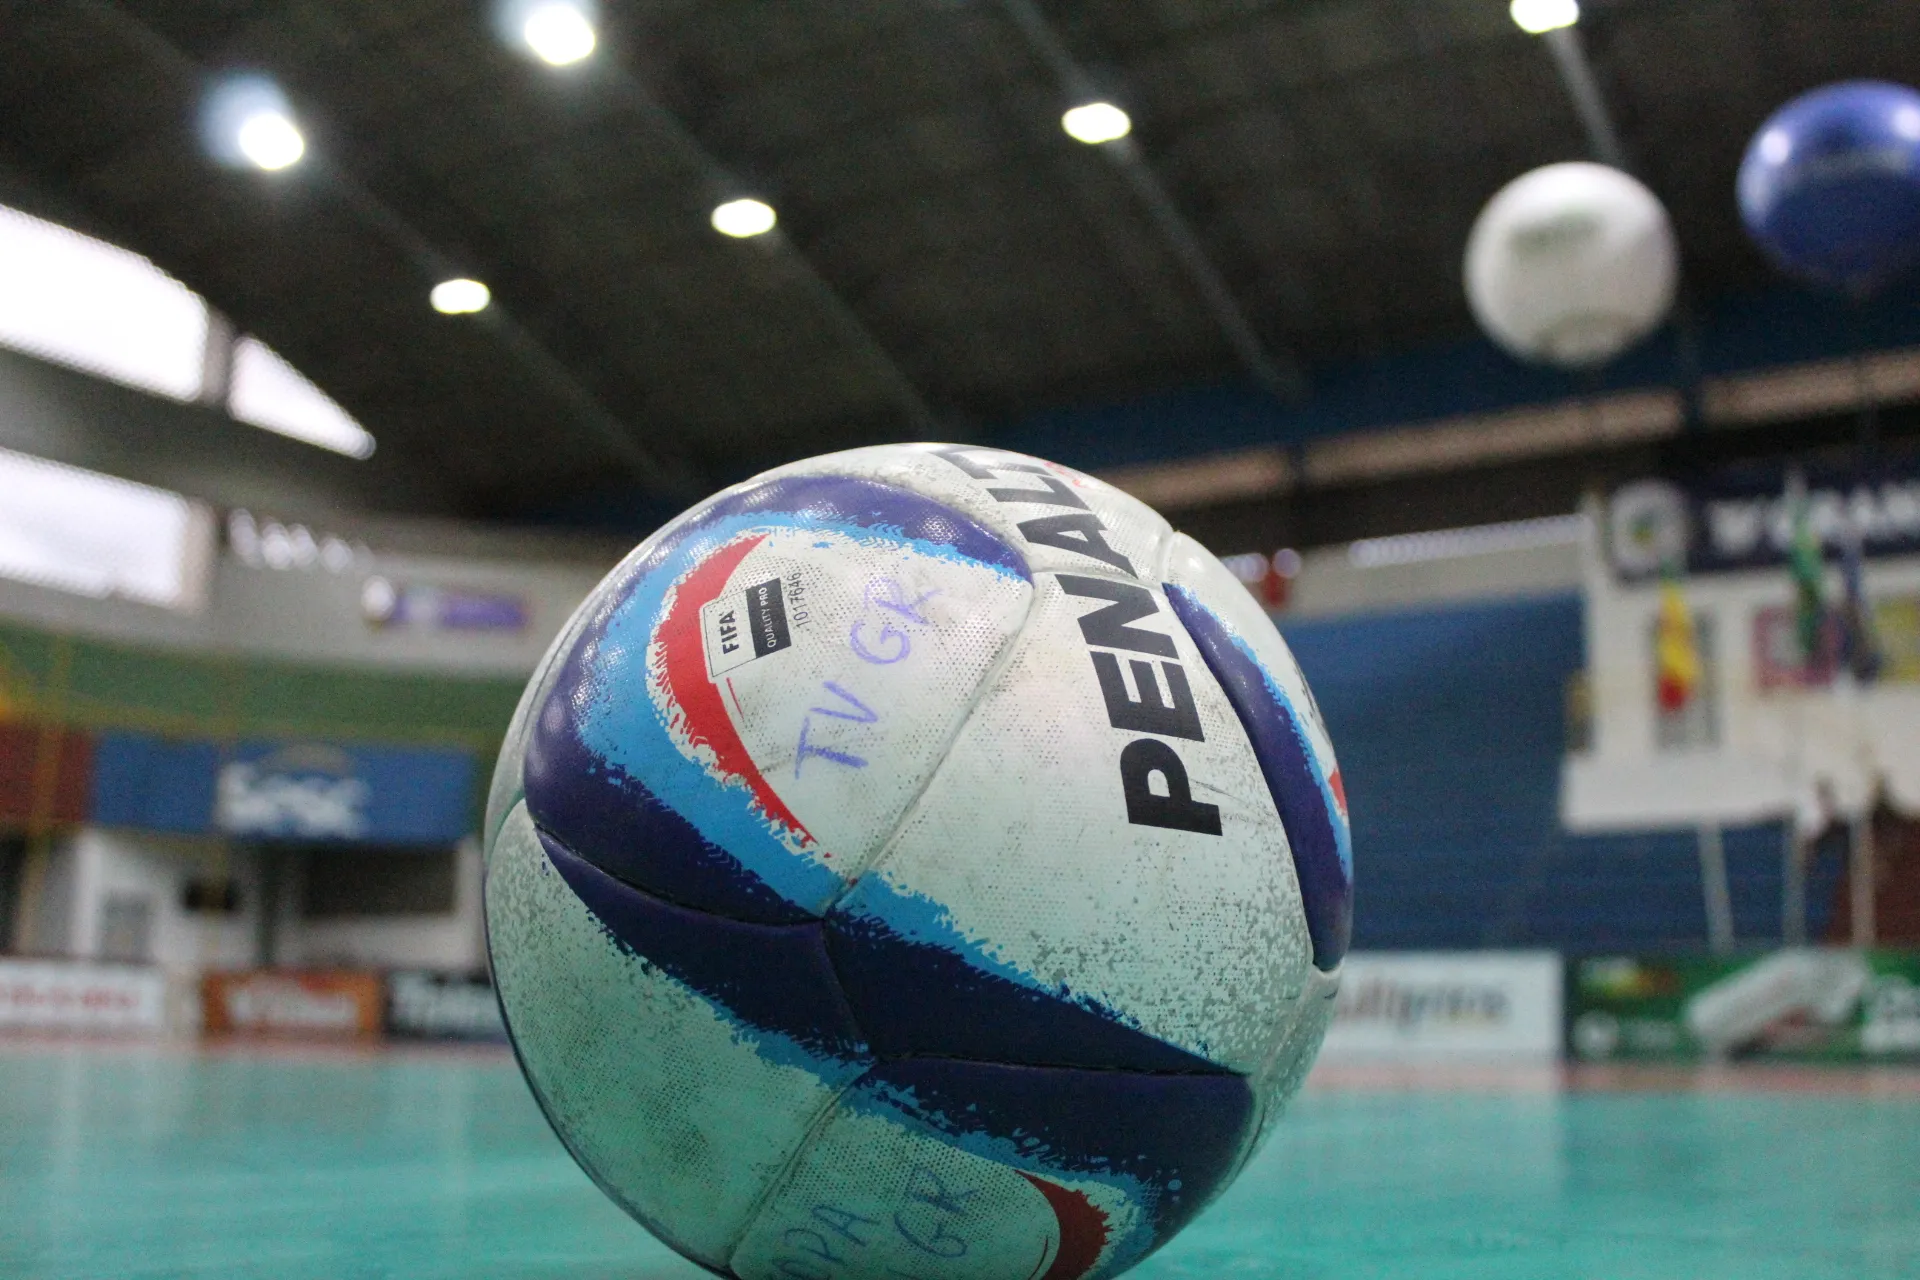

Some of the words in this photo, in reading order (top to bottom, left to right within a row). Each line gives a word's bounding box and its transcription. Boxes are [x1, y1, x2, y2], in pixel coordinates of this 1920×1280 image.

[758, 586, 769, 606] PRO
[786, 572, 812, 628] 1017646
[718, 610, 740, 655] FIFA
[760, 608, 777, 648] QUALITY
[794, 681, 879, 780] TV
